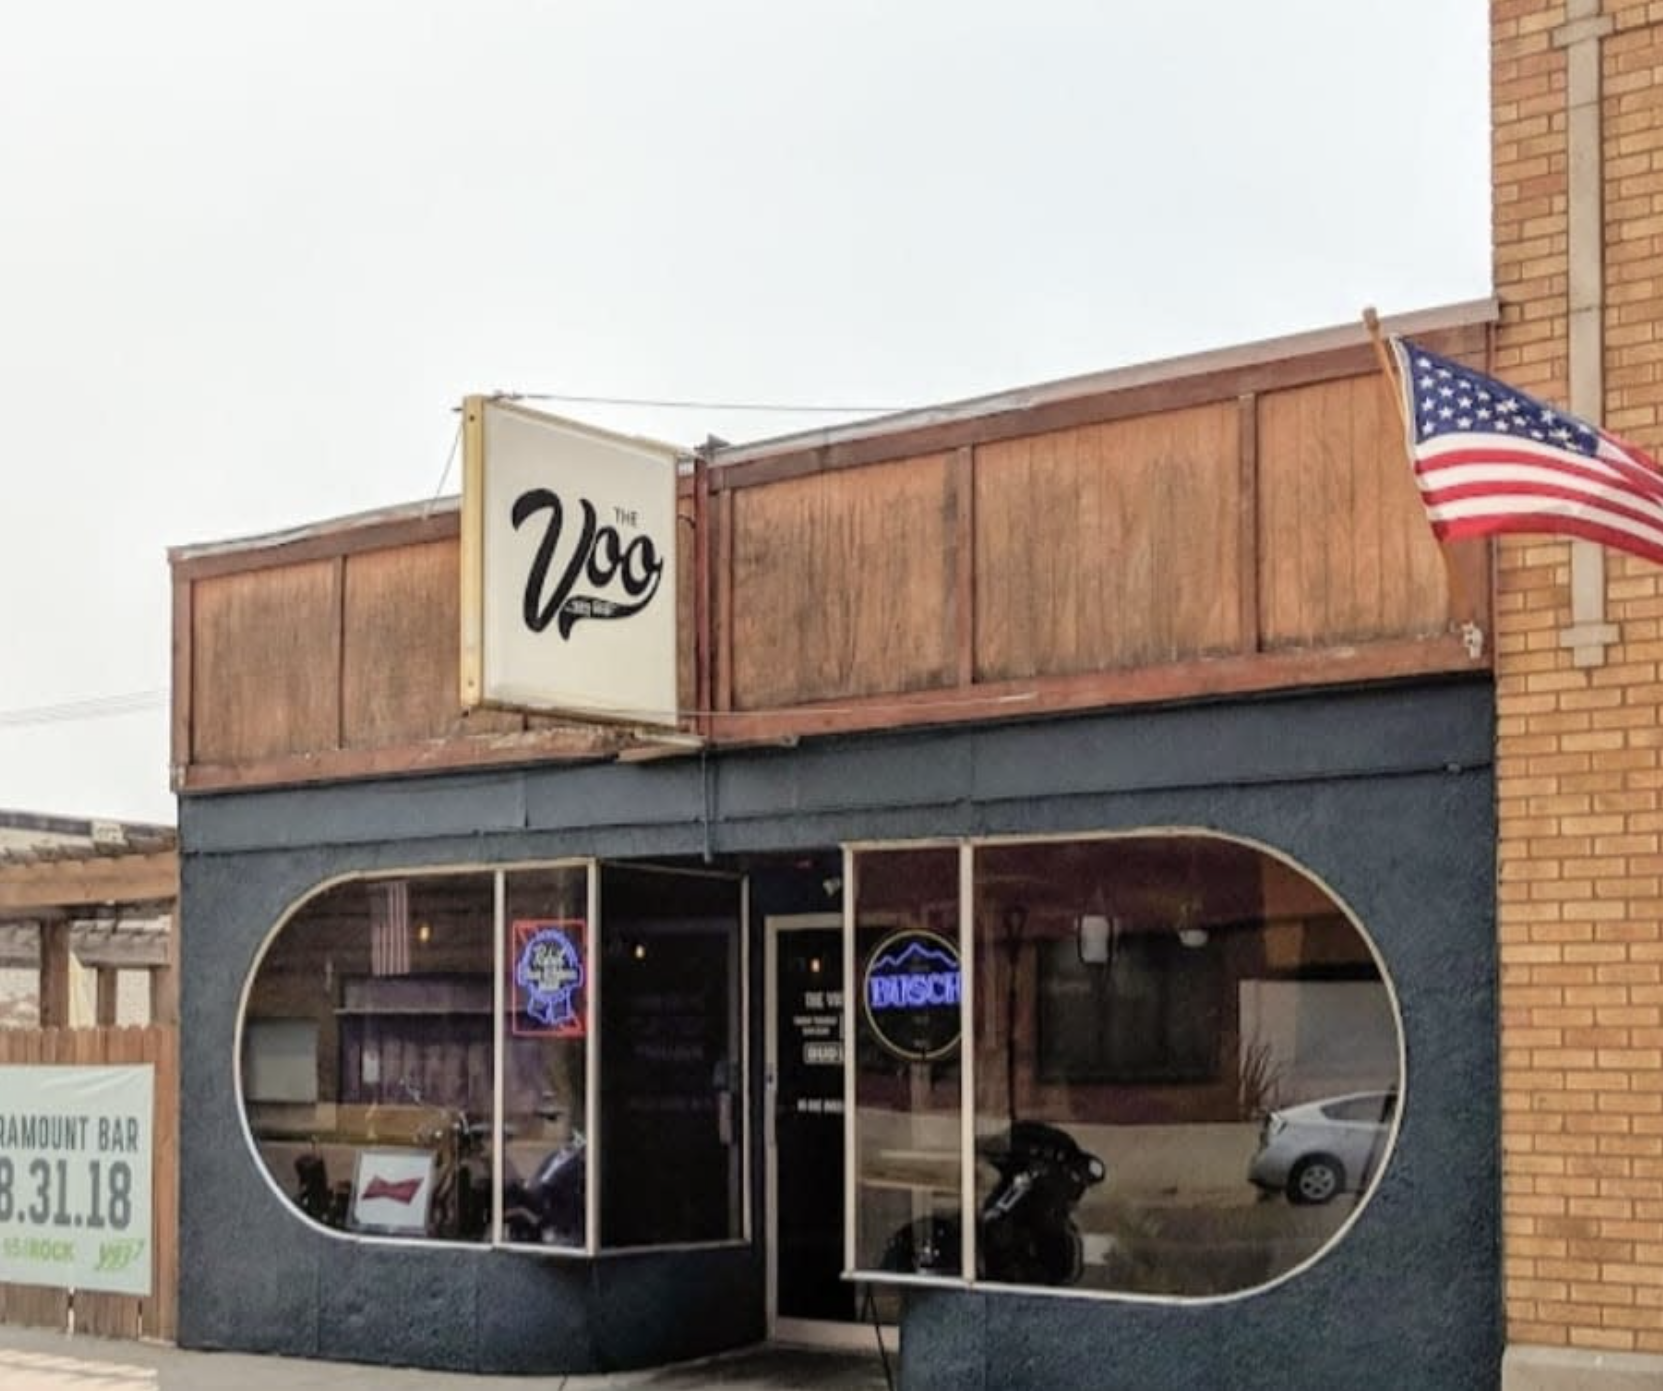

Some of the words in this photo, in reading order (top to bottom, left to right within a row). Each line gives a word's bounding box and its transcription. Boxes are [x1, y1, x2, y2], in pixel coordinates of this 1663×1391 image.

[614, 506, 638, 527] THE
[511, 488, 663, 640] Voo
[871, 973, 961, 1008] BUSCH
[98, 1116, 139, 1153] BAR
[0, 1155, 131, 1231] 8.31.18
